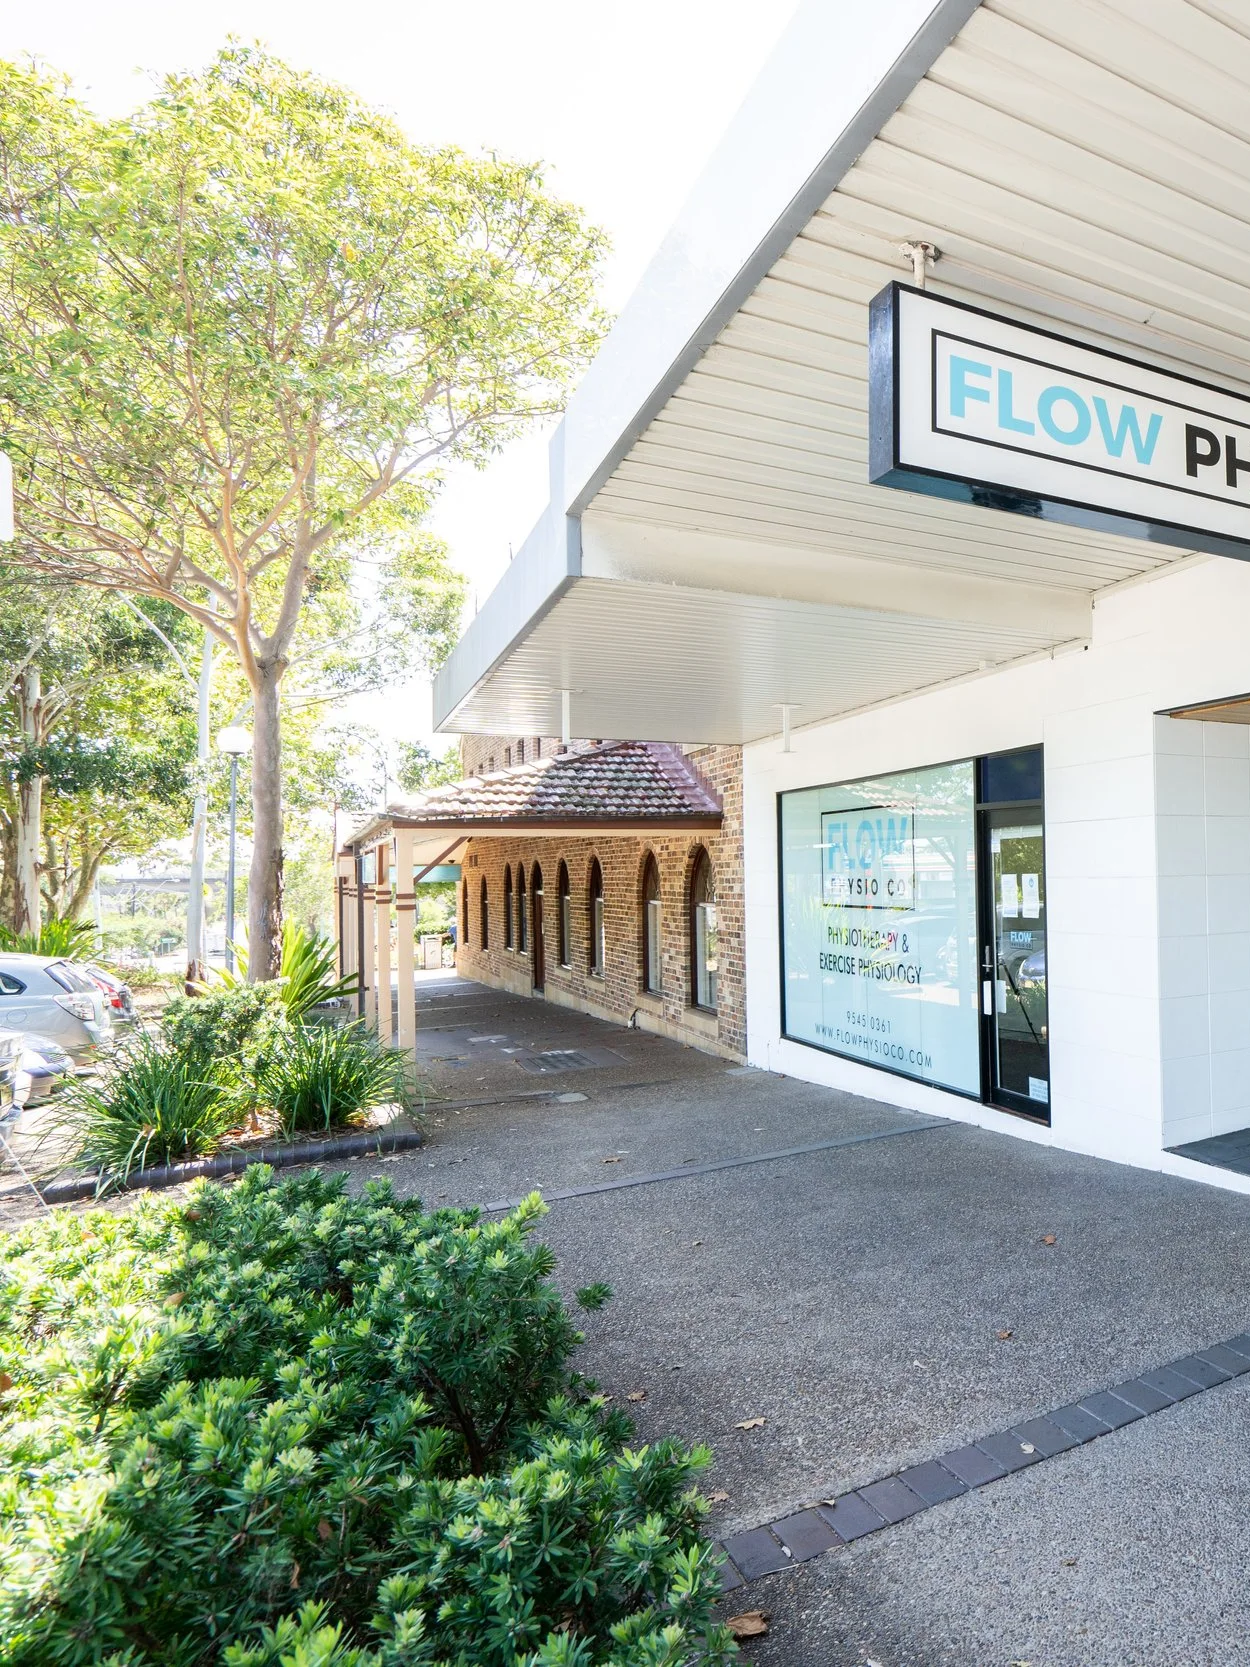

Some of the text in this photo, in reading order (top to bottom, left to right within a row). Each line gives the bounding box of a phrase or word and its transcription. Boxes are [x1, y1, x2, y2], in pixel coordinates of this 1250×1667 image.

[949, 354, 1163, 465] FLOW
[828, 816, 908, 870] FLOW
[831, 877, 906, 897] PYSIO CO
[828, 927, 910, 953] PHYSIOTHERAPY &
[1010, 931, 1032, 943] FLOW
[819, 952, 922, 985] EXERCISE PHYSIOLOGY
[846, 1011, 892, 1034] 9545 0361
[815, 1023, 932, 1067] WWW.FLOWPHYSIOCO.COM
